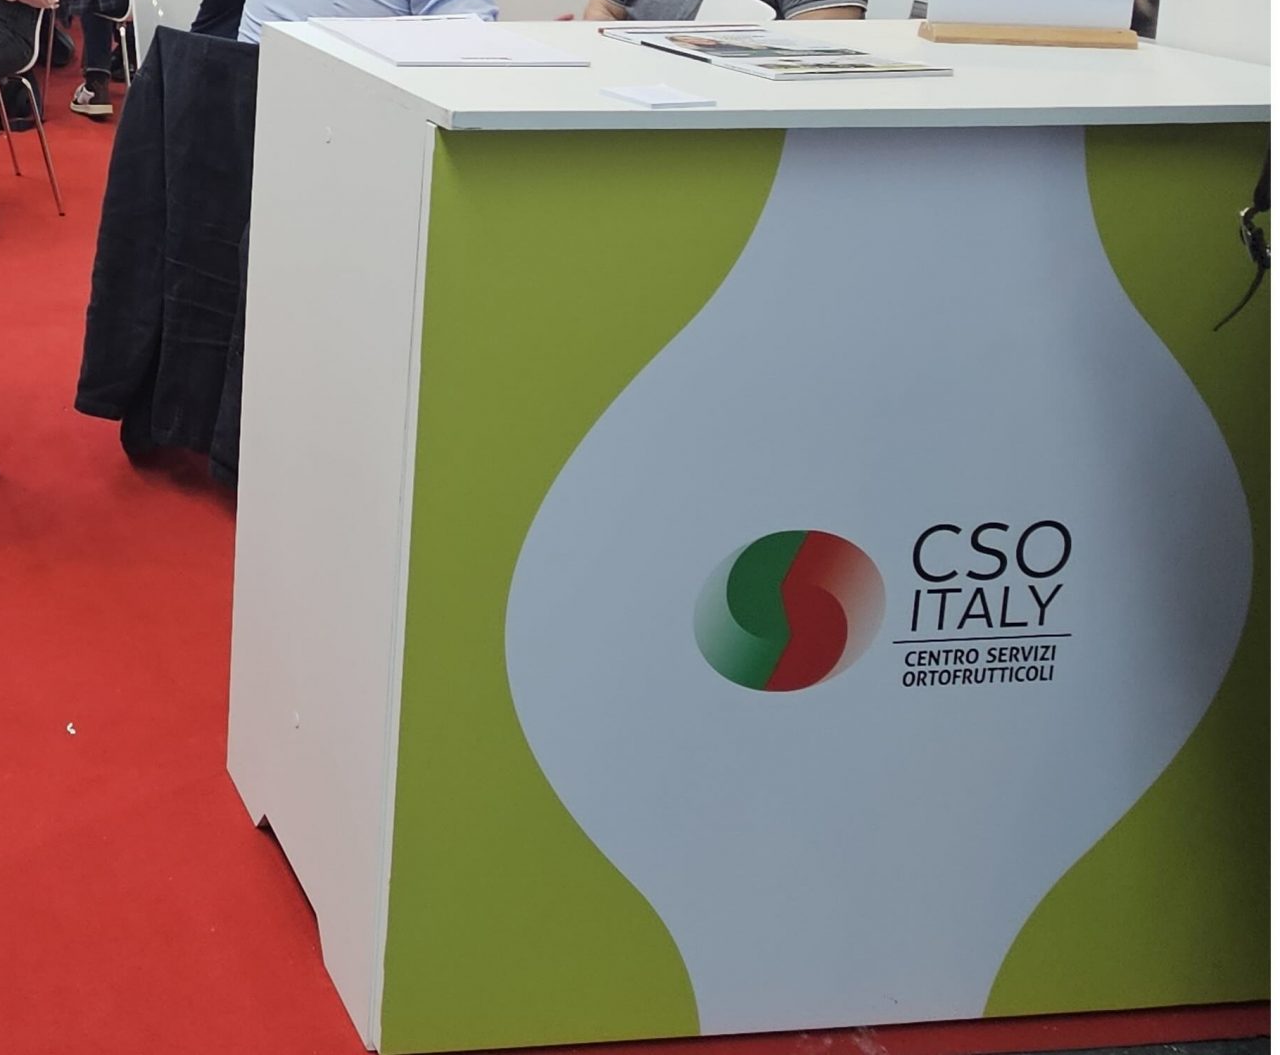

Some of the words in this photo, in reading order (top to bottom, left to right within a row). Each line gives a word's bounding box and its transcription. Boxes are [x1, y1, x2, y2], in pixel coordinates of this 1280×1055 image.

[912, 519, 1072, 583] CSO
[910, 583, 1064, 632] ITALY
[904, 648, 980, 667] CENTRO
[985, 645, 1057, 664] SERVIZI
[902, 665, 1054, 688] ORTOFRUTTICOLI
